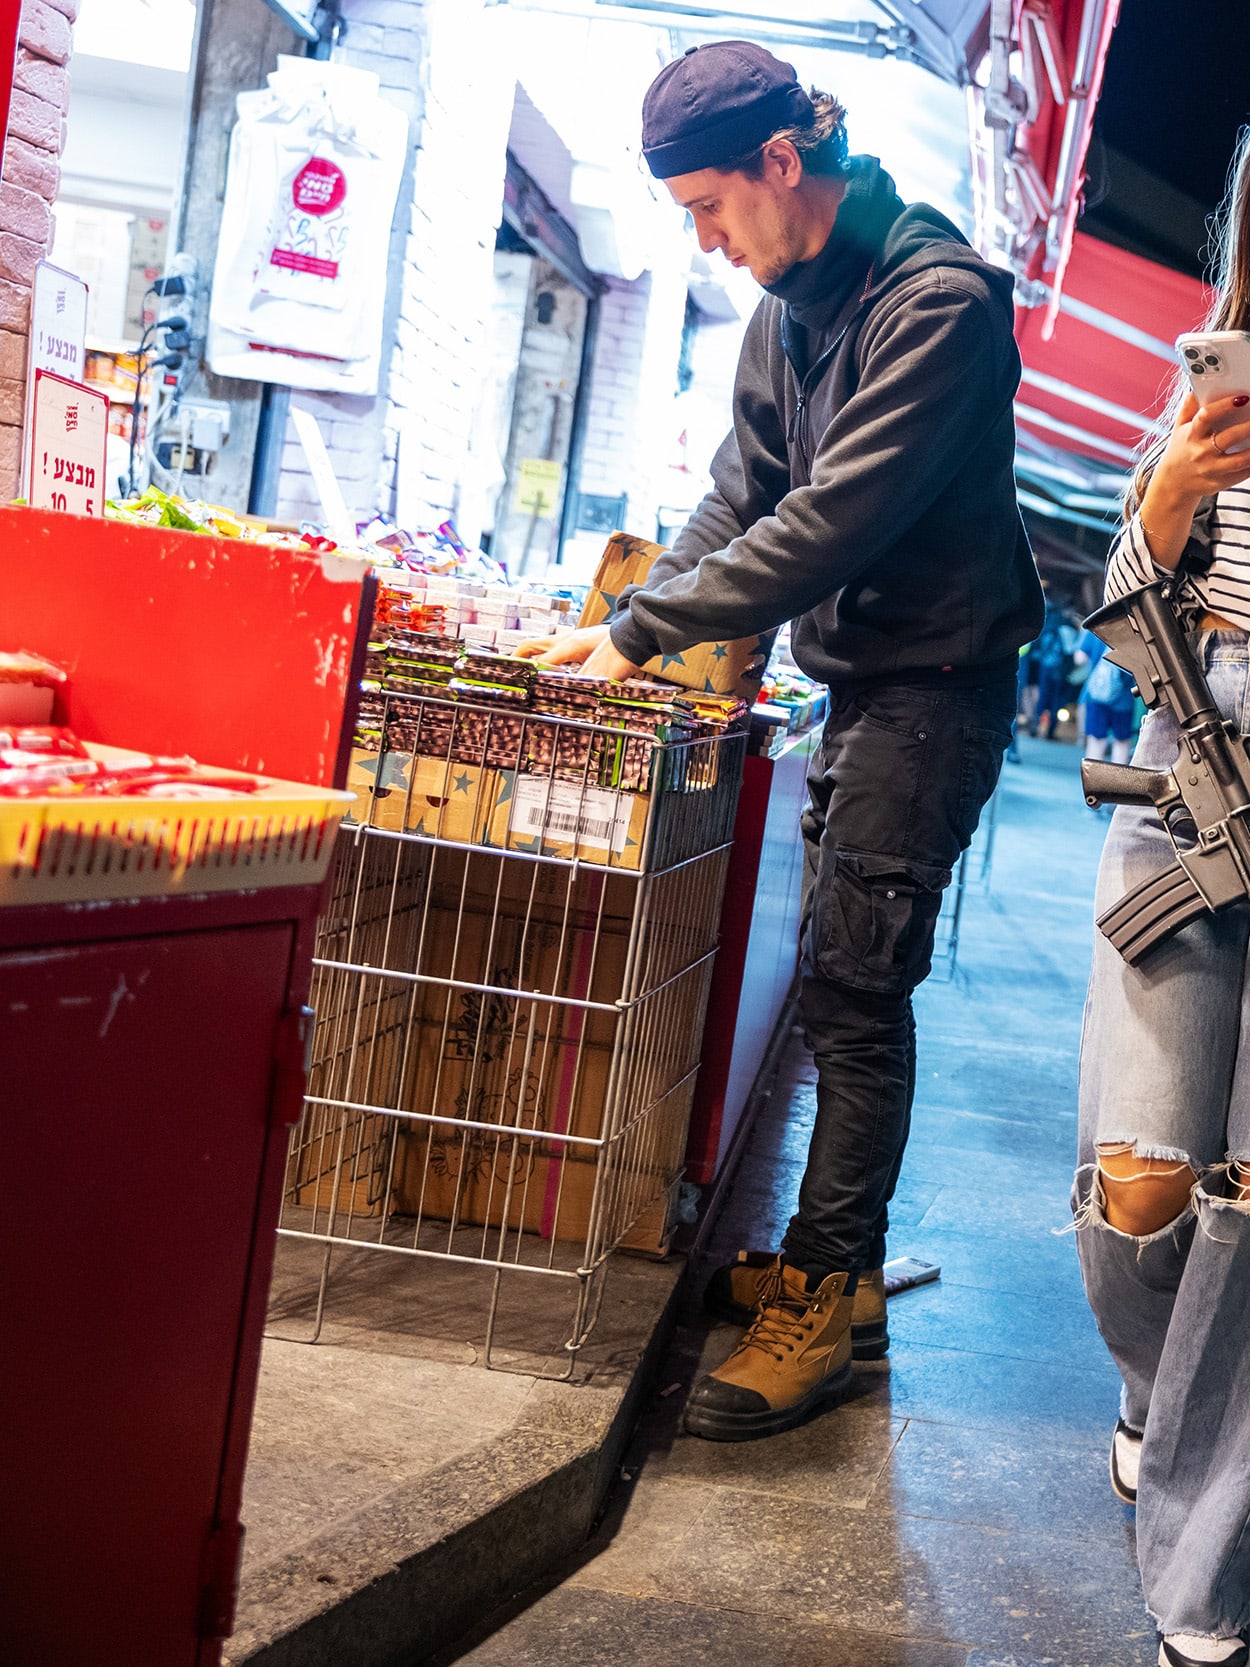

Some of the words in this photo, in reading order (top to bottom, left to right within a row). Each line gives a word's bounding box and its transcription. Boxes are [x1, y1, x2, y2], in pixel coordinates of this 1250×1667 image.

[46, 335, 77, 363] מבצע
[53, 457, 95, 488] מבצע
[51, 492, 67, 512] 10
[85, 499, 93, 516] 5
